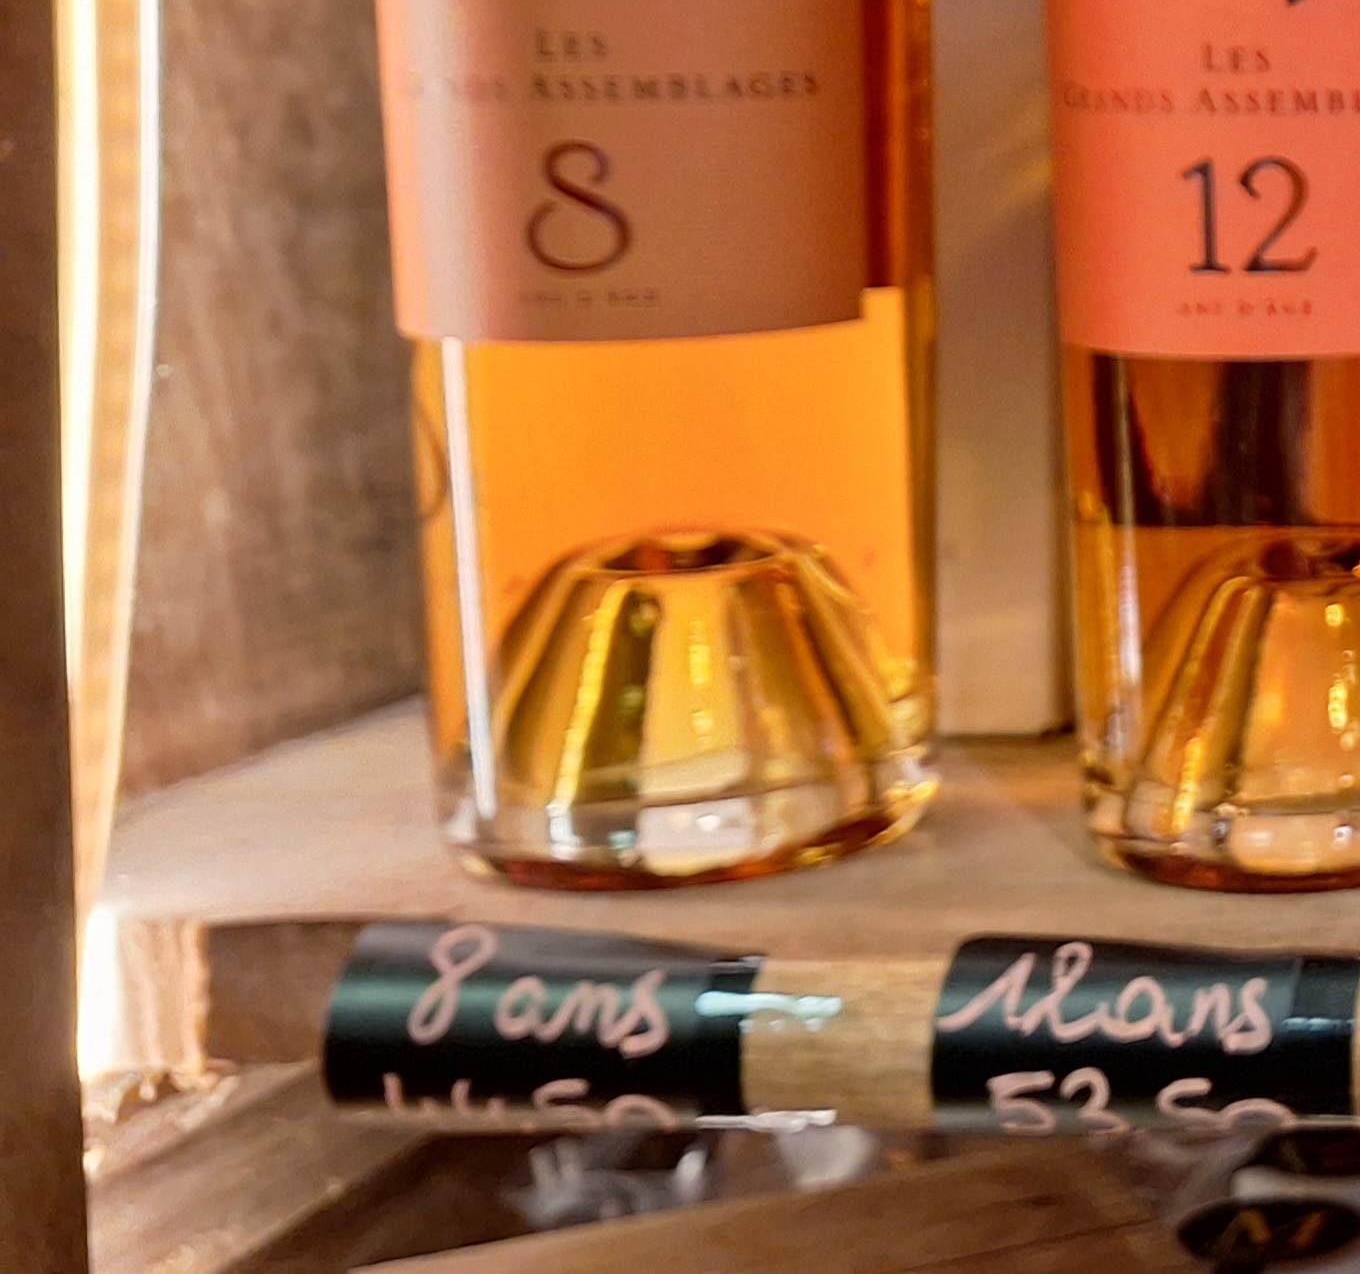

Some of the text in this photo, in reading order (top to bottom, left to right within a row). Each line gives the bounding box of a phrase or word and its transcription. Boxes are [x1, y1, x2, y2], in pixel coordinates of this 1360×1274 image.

[1204, 42, 1271, 74] LES
[527, 142, 632, 272] 8
[1181, 155, 1318, 274] 12
[407, 924, 670, 1059] 8 ans
